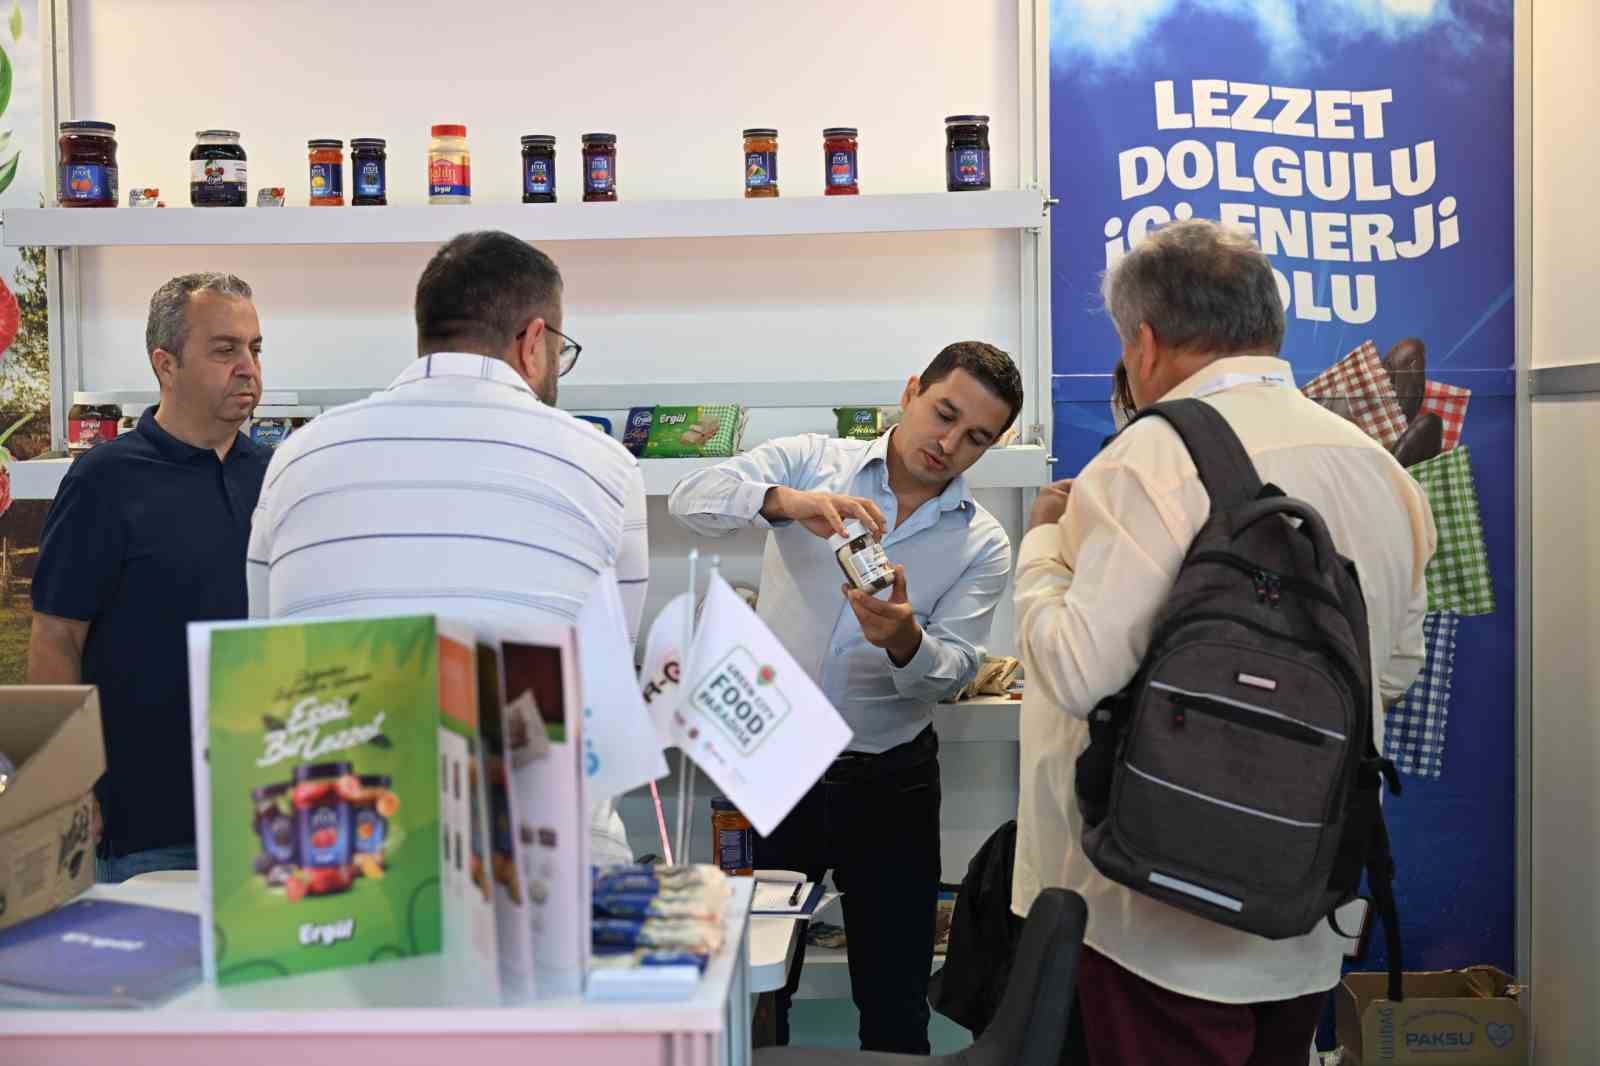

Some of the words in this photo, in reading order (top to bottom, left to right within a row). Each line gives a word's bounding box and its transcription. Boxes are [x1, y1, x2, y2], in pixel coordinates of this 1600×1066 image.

[1154, 79, 1392, 139] LEZZET
[1118, 139, 1436, 201] DOLGULU
[659, 412, 687, 425] Ergül
[709, 673, 765, 735] FOOD
[1406, 1031, 1473, 1048] PAKSU
